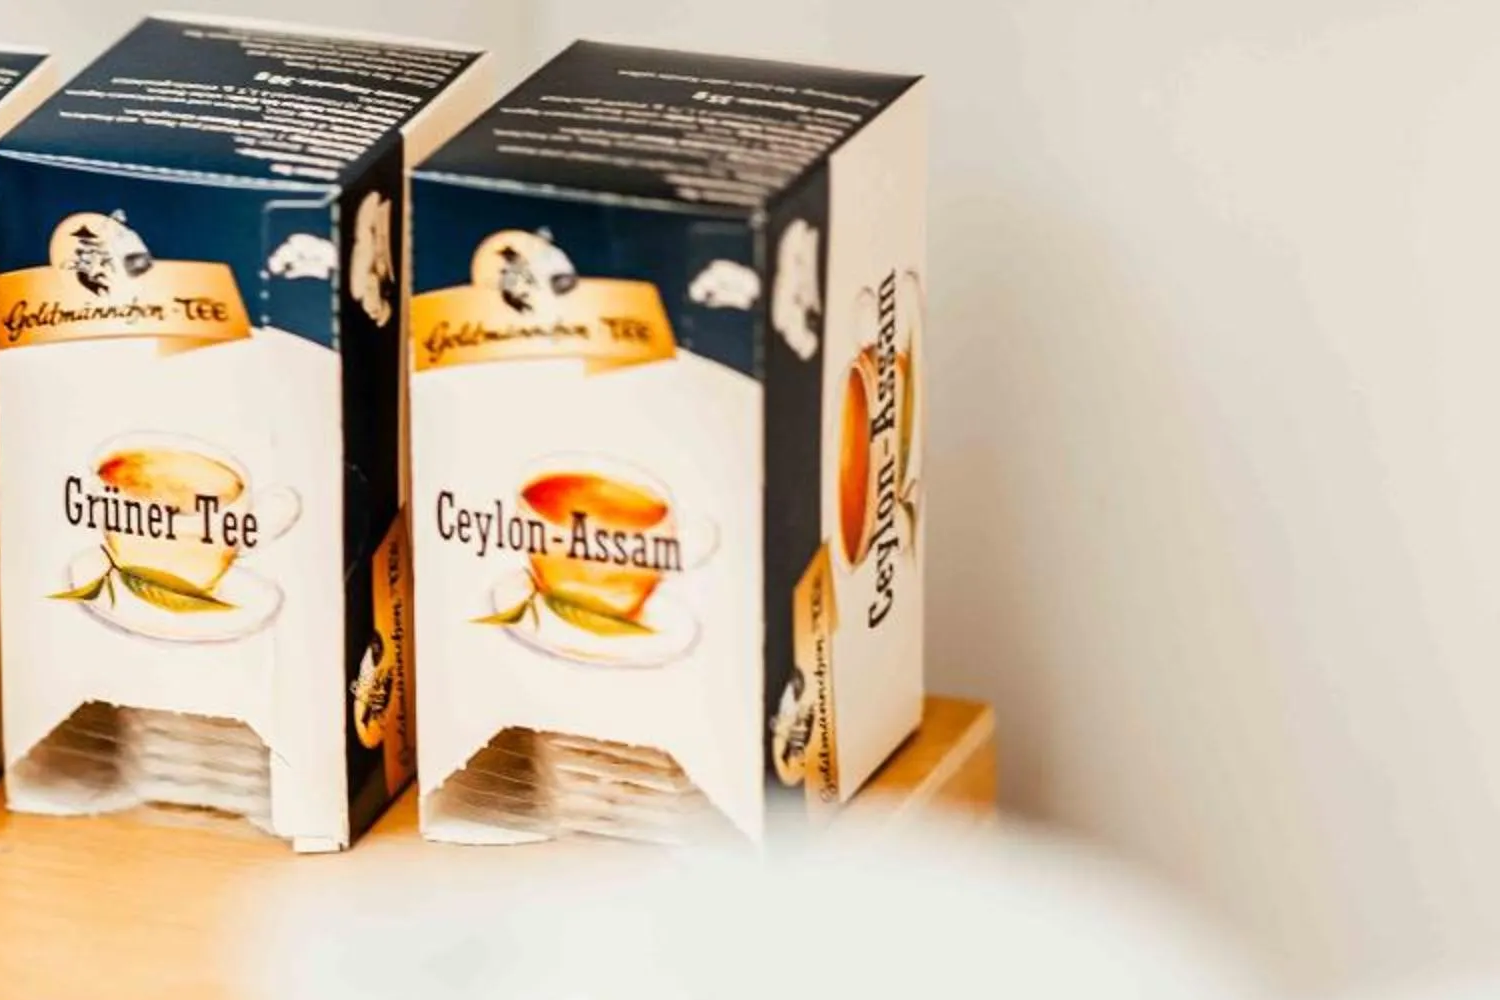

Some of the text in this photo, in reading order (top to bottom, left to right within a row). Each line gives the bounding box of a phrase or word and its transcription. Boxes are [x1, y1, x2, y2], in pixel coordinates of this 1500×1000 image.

[868, 268, 900, 629] Ceylon-Assam
[64, 475, 258, 548] Grüner Tee
[436, 490, 684, 571] Ceylon-Assam
